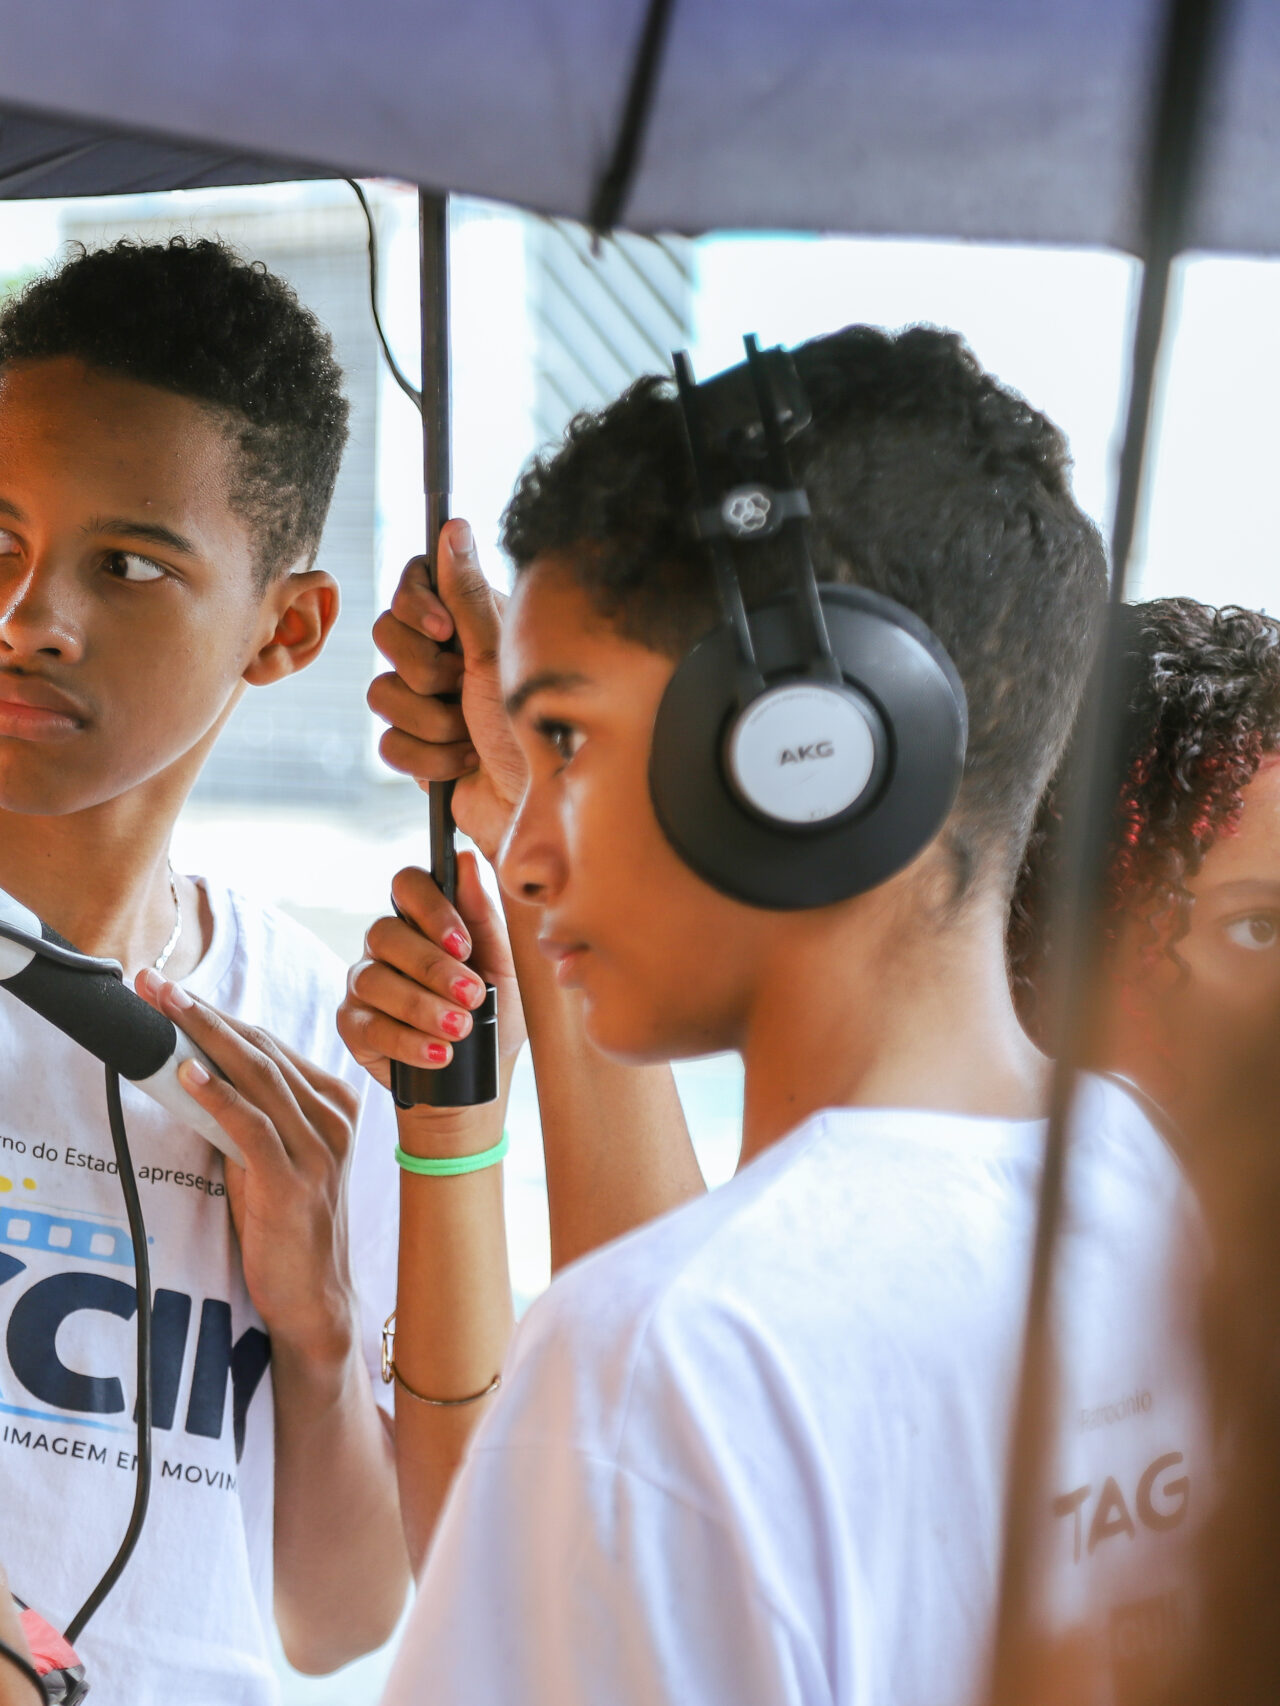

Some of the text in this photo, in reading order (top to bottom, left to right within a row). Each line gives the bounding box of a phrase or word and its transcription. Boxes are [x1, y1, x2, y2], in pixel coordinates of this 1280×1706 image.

[779, 740, 835, 766] AKG
[32, 1142, 59, 1162] do
[65, 1147, 120, 1176] Estad
[3, 1426, 106, 1464] IMAGEM
[1052, 1451, 1191, 1566] TAG
